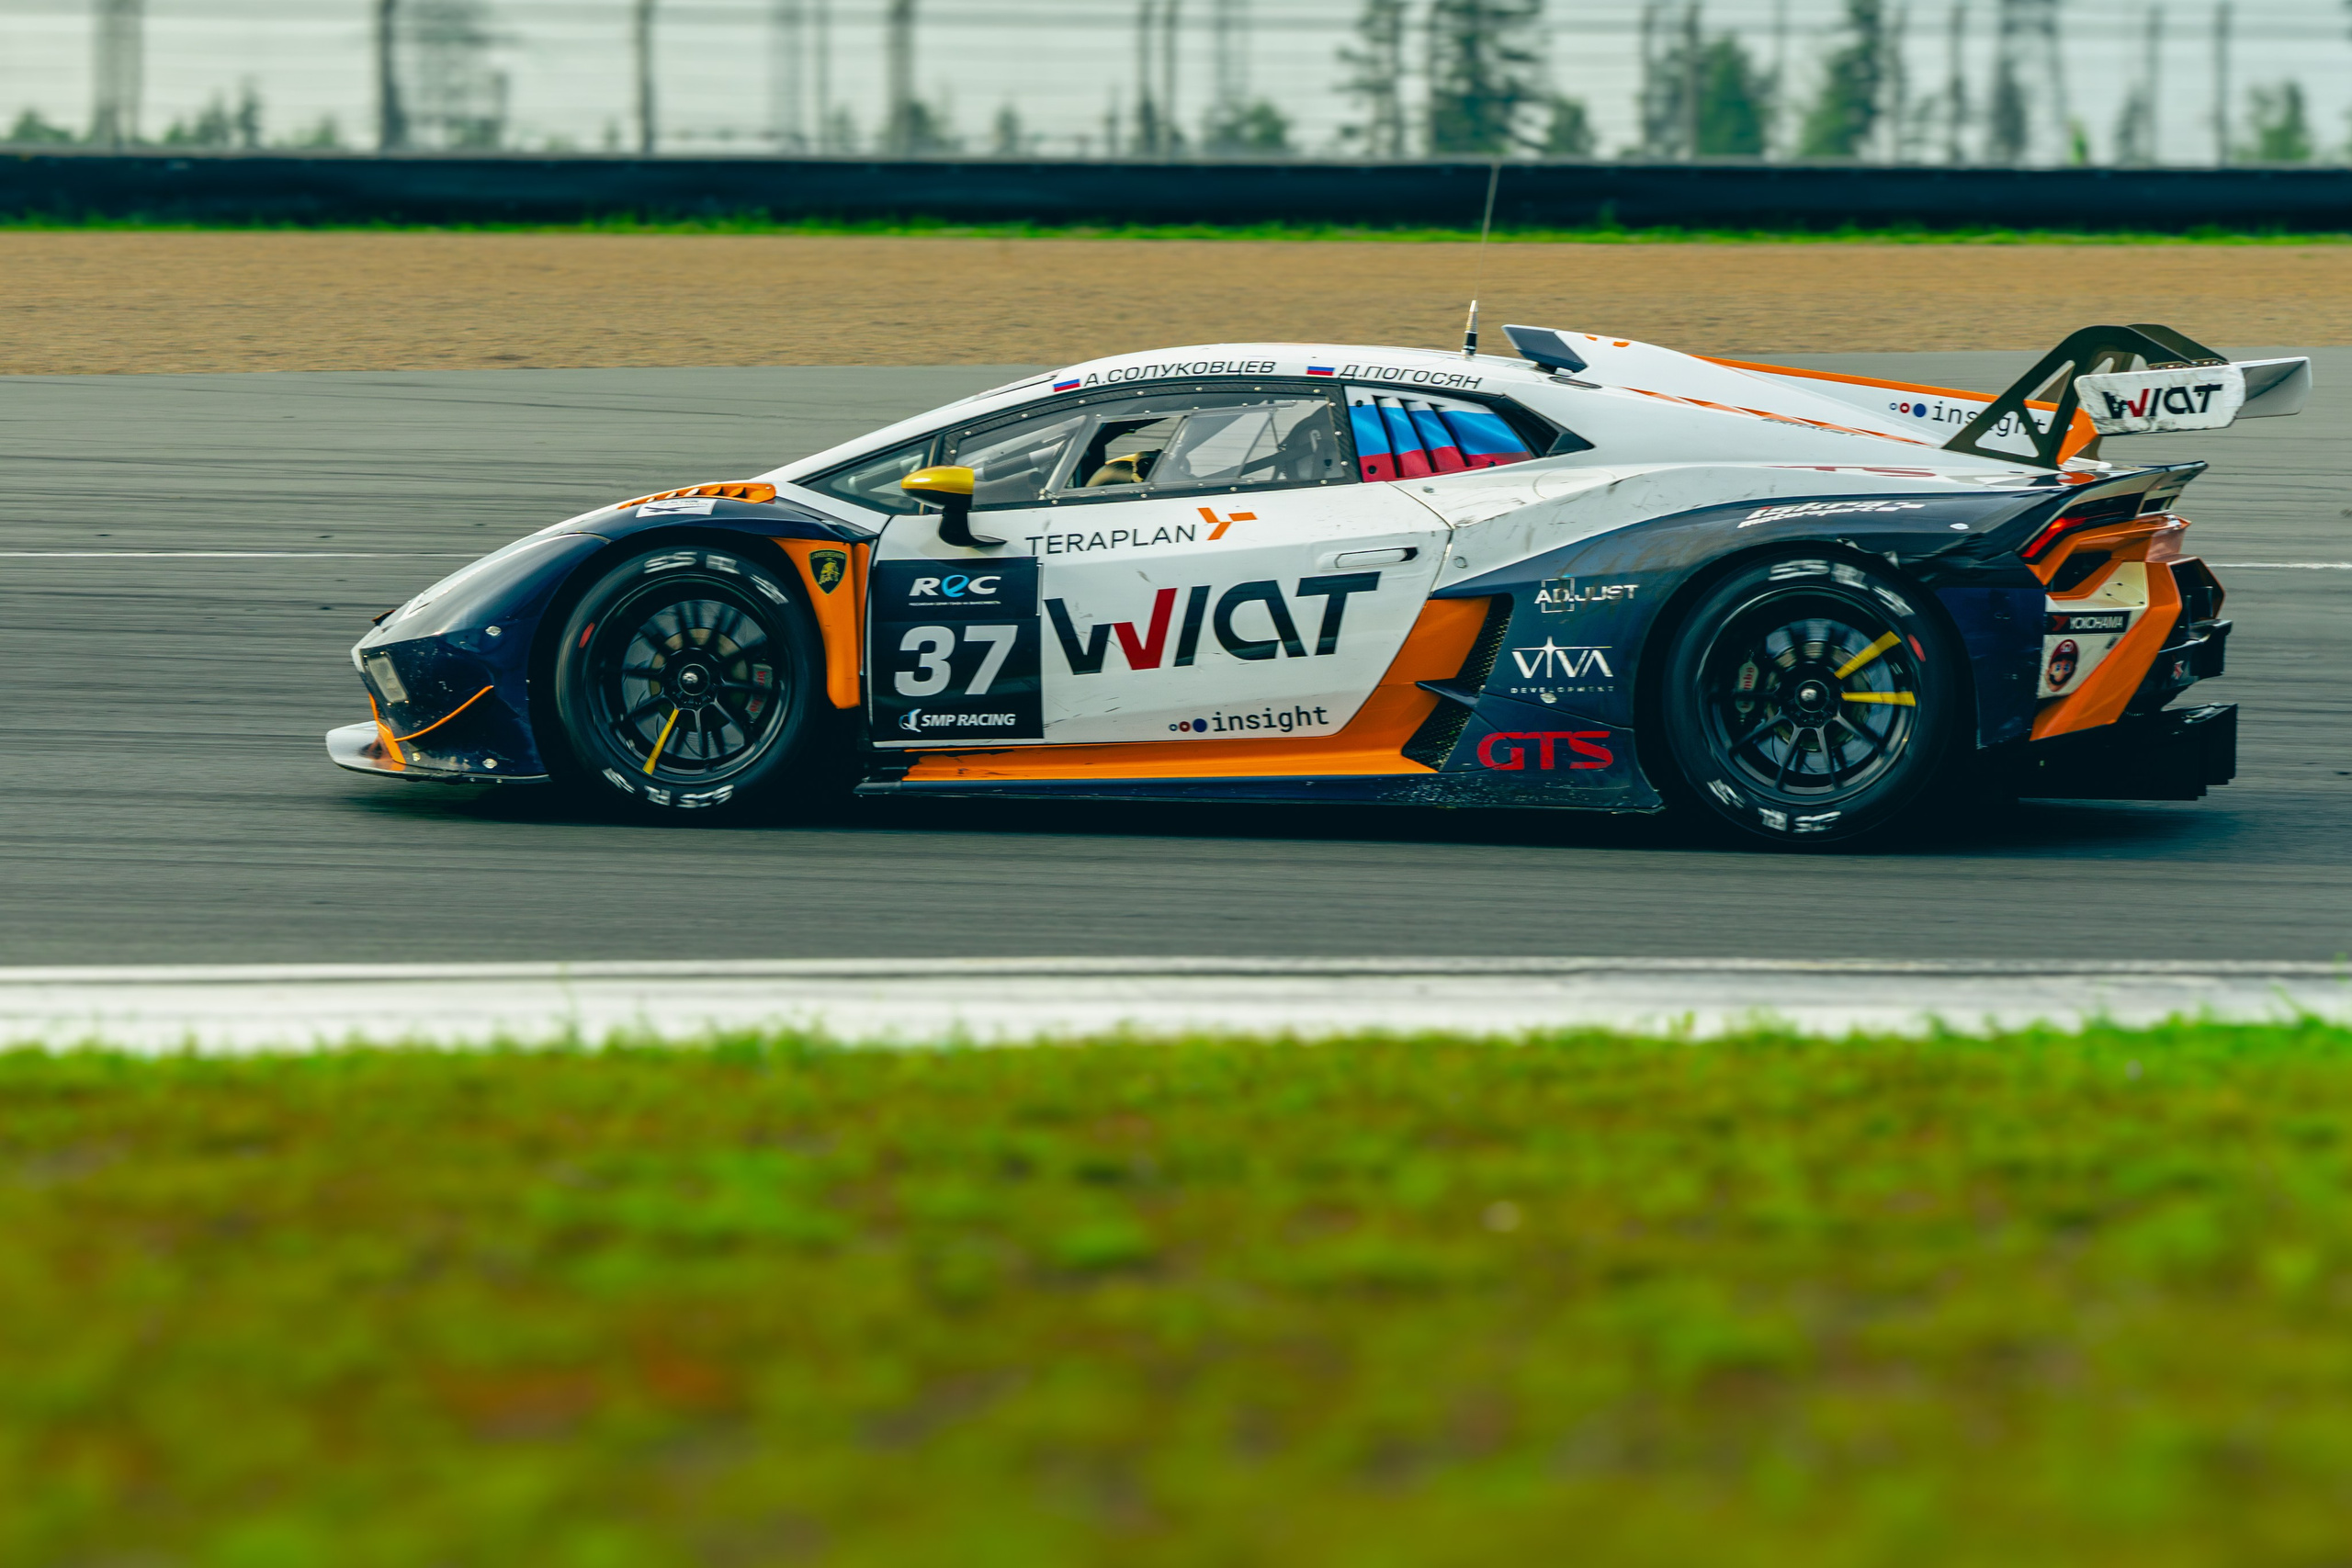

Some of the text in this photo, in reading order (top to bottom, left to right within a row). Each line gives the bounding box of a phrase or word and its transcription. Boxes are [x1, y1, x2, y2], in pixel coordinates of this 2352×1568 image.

[1084, 360, 1277, 387] А.СОЛУКОВЦЕВ
[1339, 364, 1484, 389] Д.ПОГОСЯН
[1024, 524, 1196, 556] TERAPLAN
[894, 625, 1019, 697] 37
[1511, 636, 1614, 679] VIVA
[920, 713, 1017, 728] SMP RACING
[1211, 705, 1330, 733] insight
[1476, 730, 1614, 770] GTS
